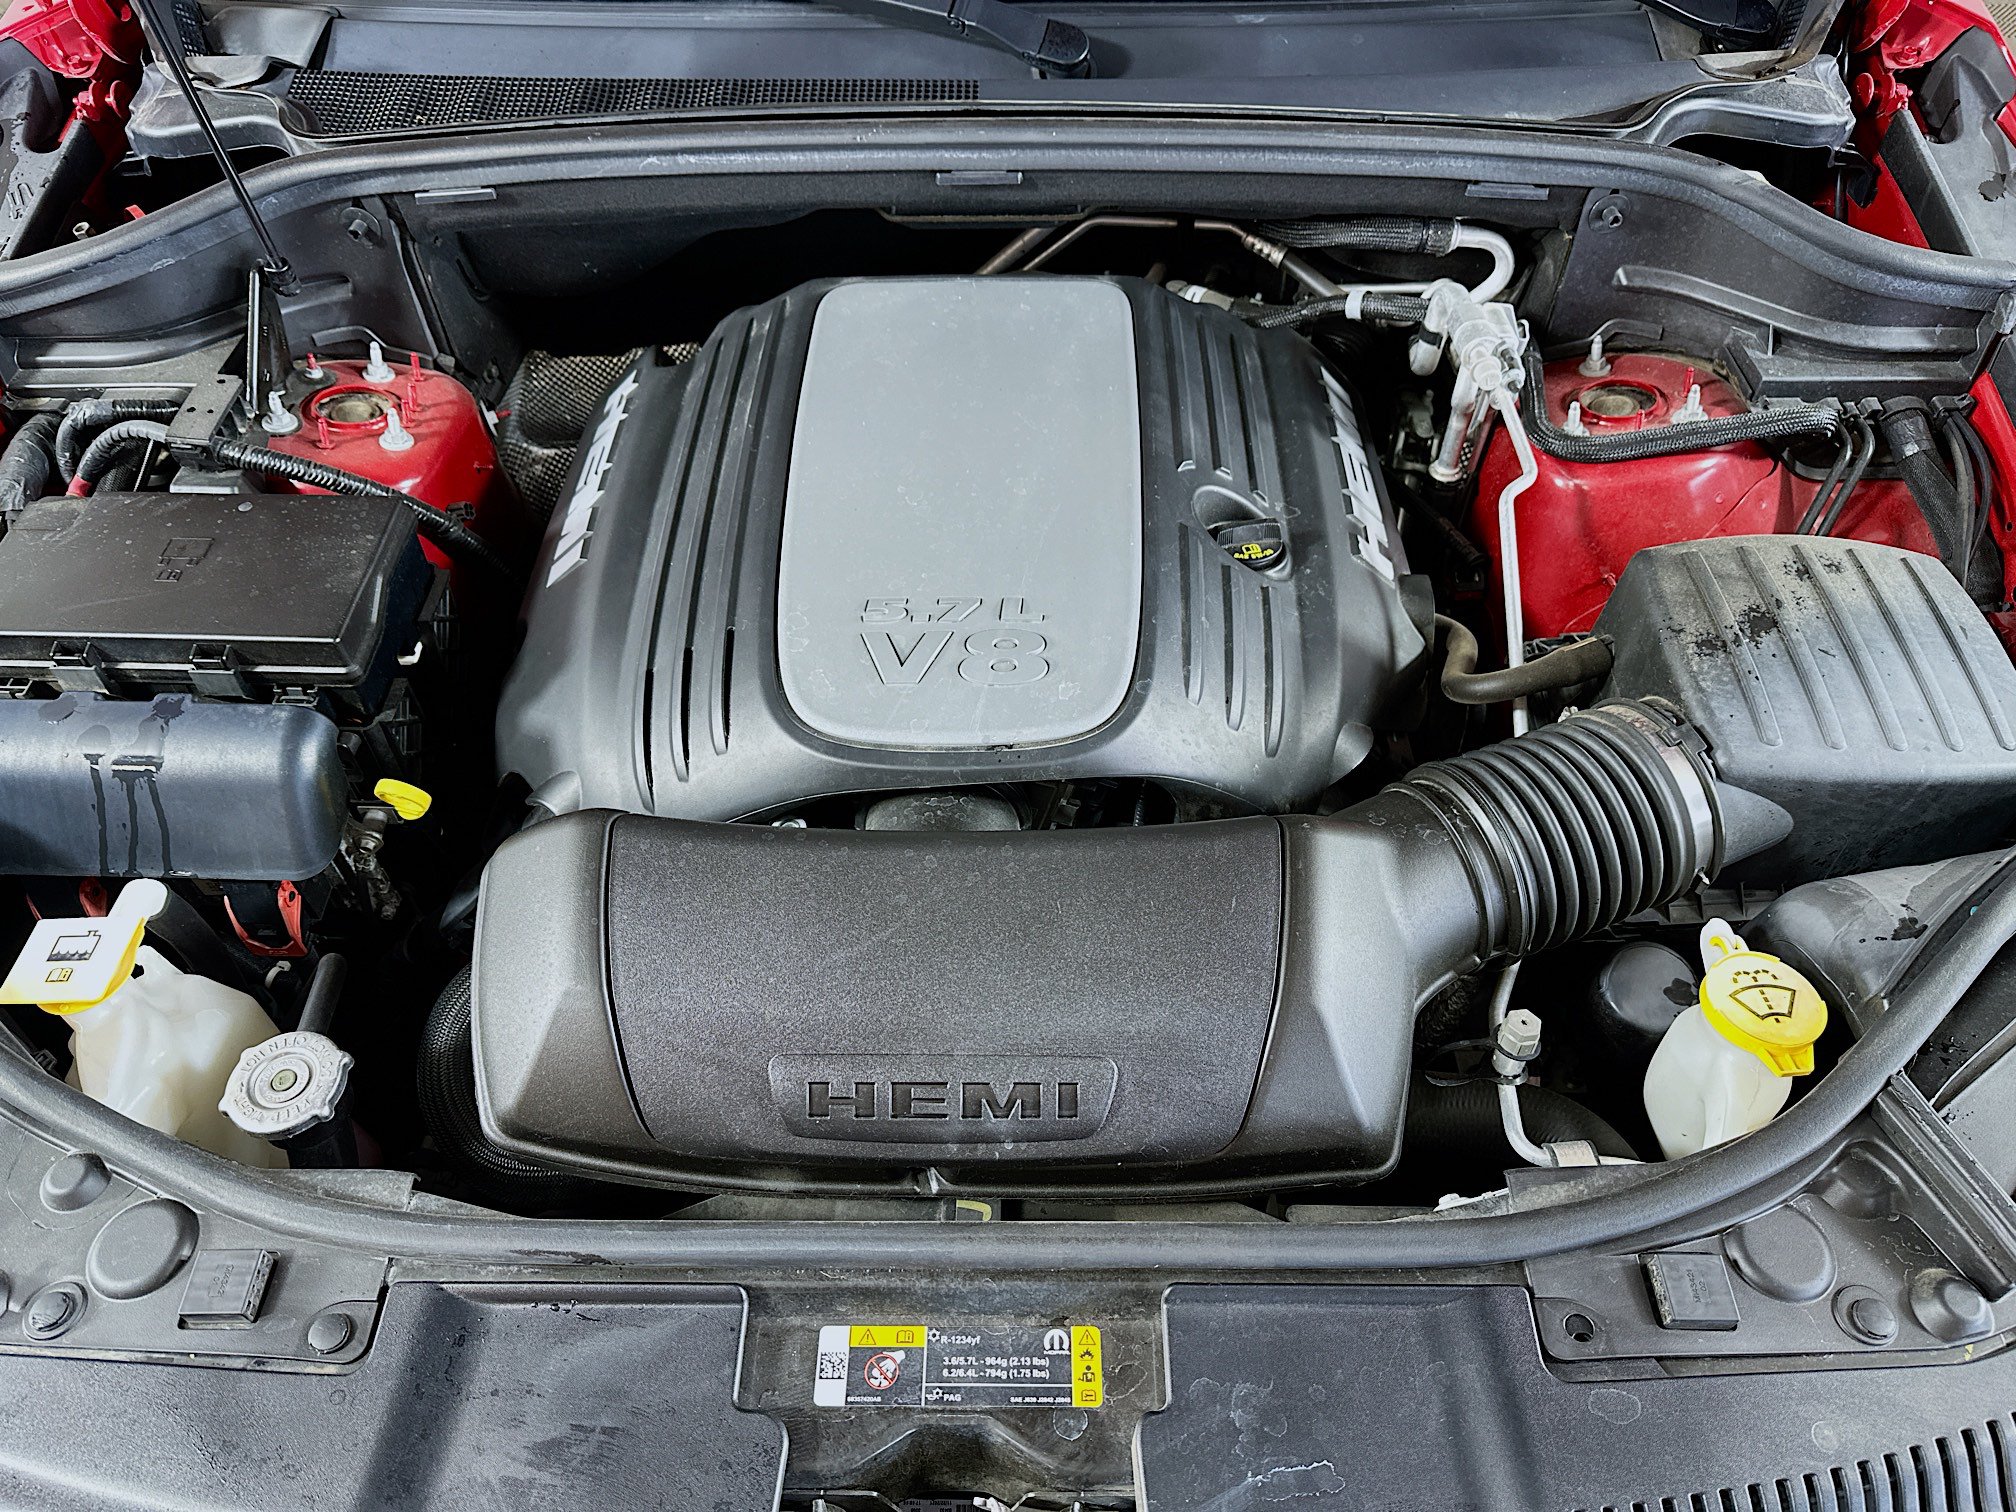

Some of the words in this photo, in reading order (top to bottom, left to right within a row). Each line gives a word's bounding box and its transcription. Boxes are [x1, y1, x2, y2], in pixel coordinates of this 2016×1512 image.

[860, 629, 1050, 686] V8
[806, 1081, 1080, 1120] HEMI
[940, 1335, 981, 1346] R-1234yf
[942, 1357, 979, 1366] 3.6/5.7L
[985, 1357, 1008, 1367] 964g
[1009, 1357, 1031, 1367] (2.13
[1033, 1356, 1050, 1367] lbs)
[942, 1369, 979, 1378] 6.2/6.4L
[985, 1369, 1008, 1379] 794g
[1009, 1369, 1031, 1379] (1.75
[1033, 1369, 1050, 1379] lbs)
[943, 1393, 962, 1402] PAG
